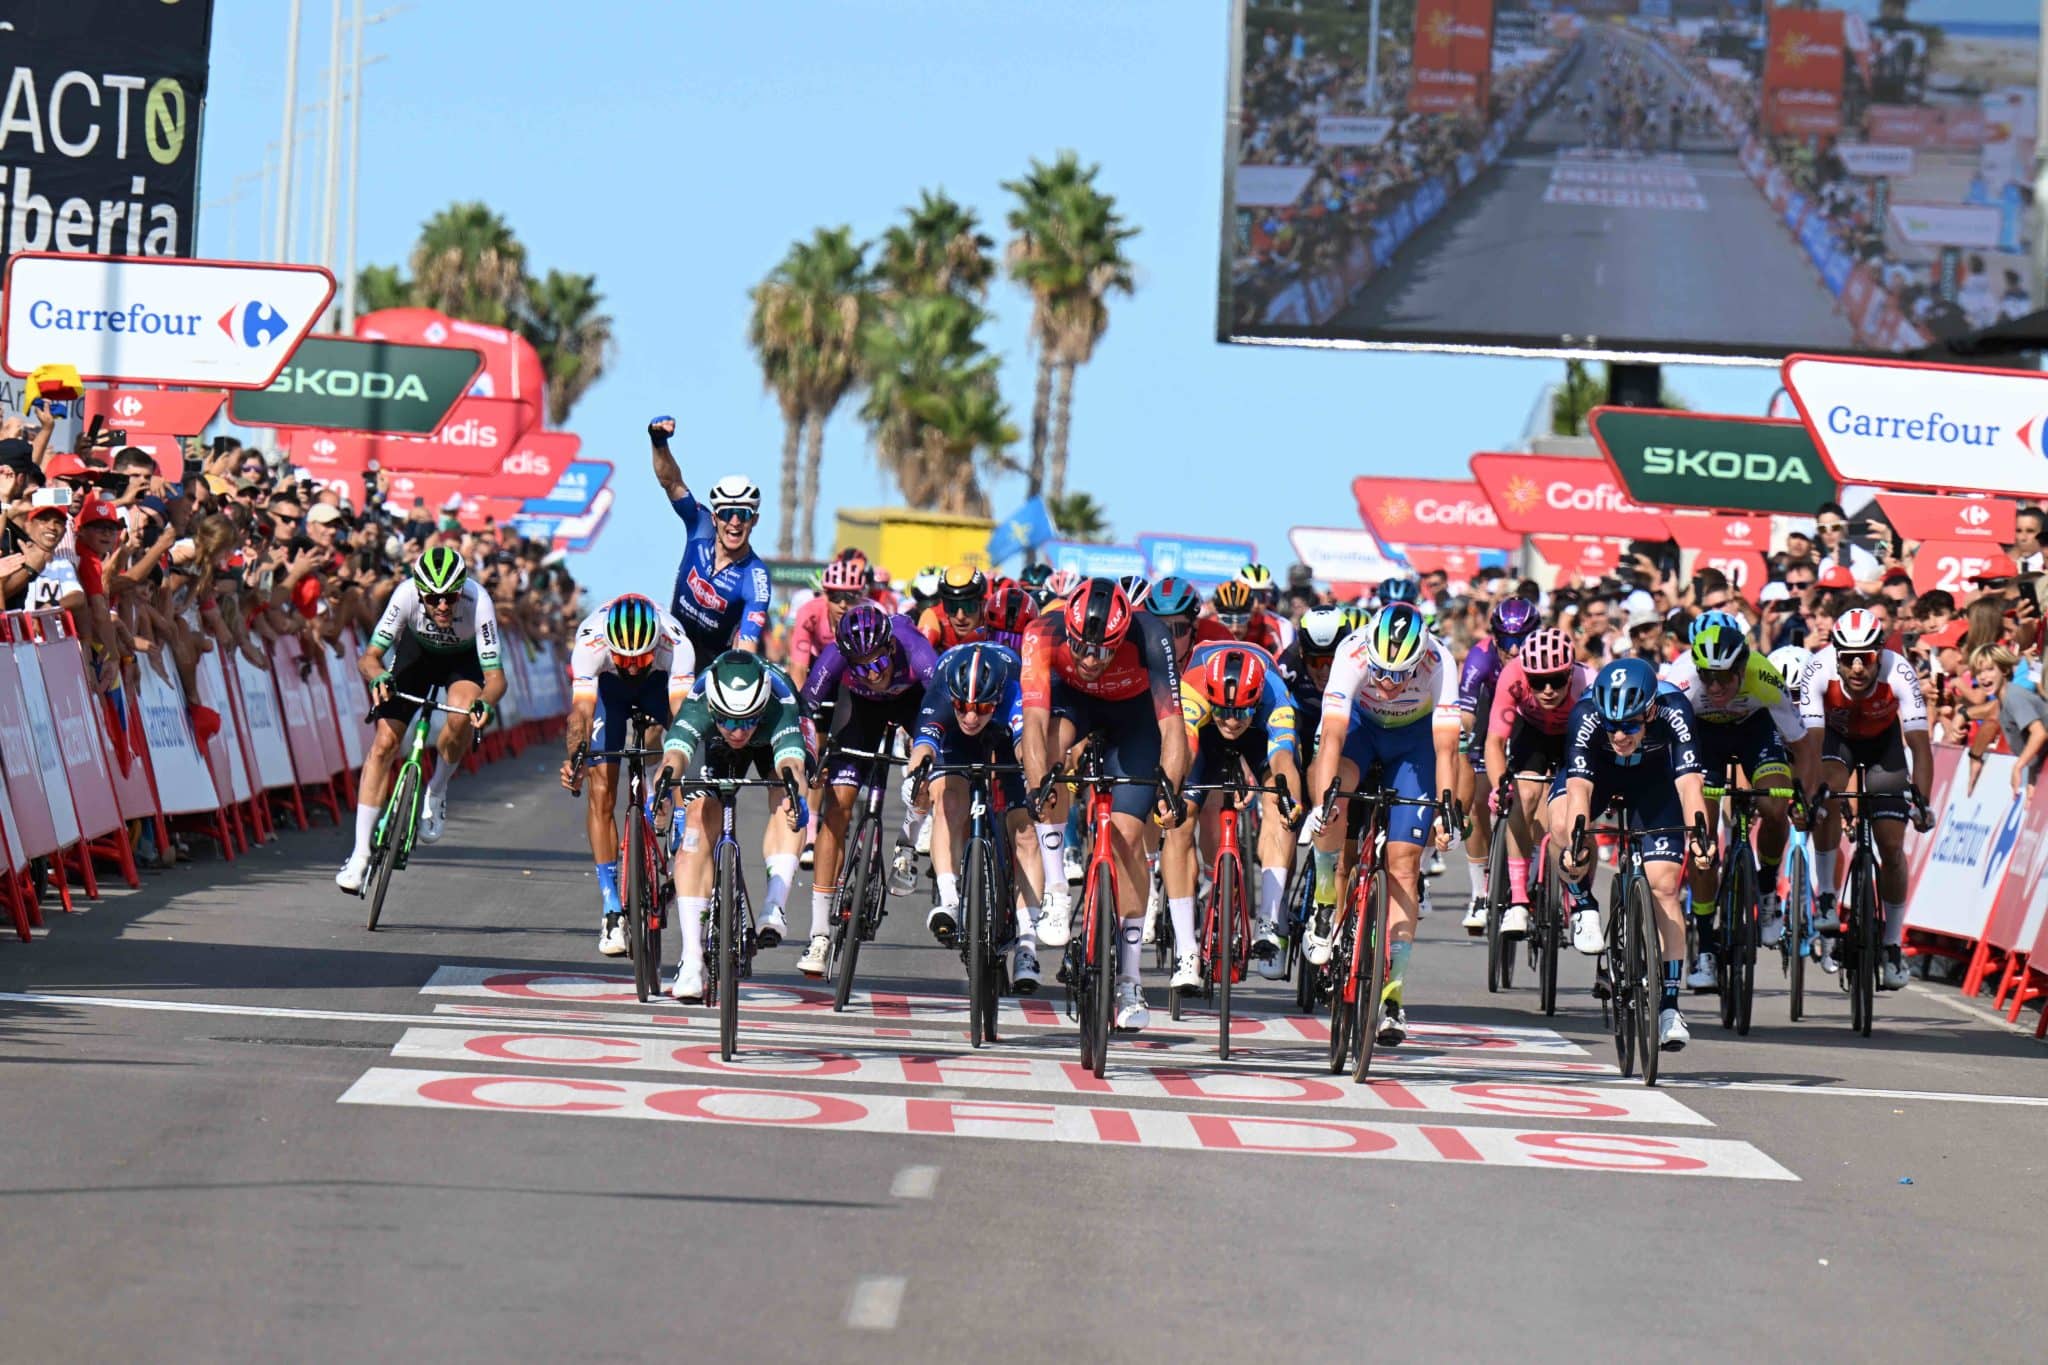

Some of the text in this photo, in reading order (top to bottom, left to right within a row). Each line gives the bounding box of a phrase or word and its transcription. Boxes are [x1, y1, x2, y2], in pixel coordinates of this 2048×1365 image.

[29, 300, 202, 336] Carrefour
[1828, 405, 2001, 447] Carrefour
[1160, 637, 1181, 707] GRENADIER
[464, 1033, 1629, 1117] COFIDIS
[416, 1076, 1708, 1171] COFIDIS
